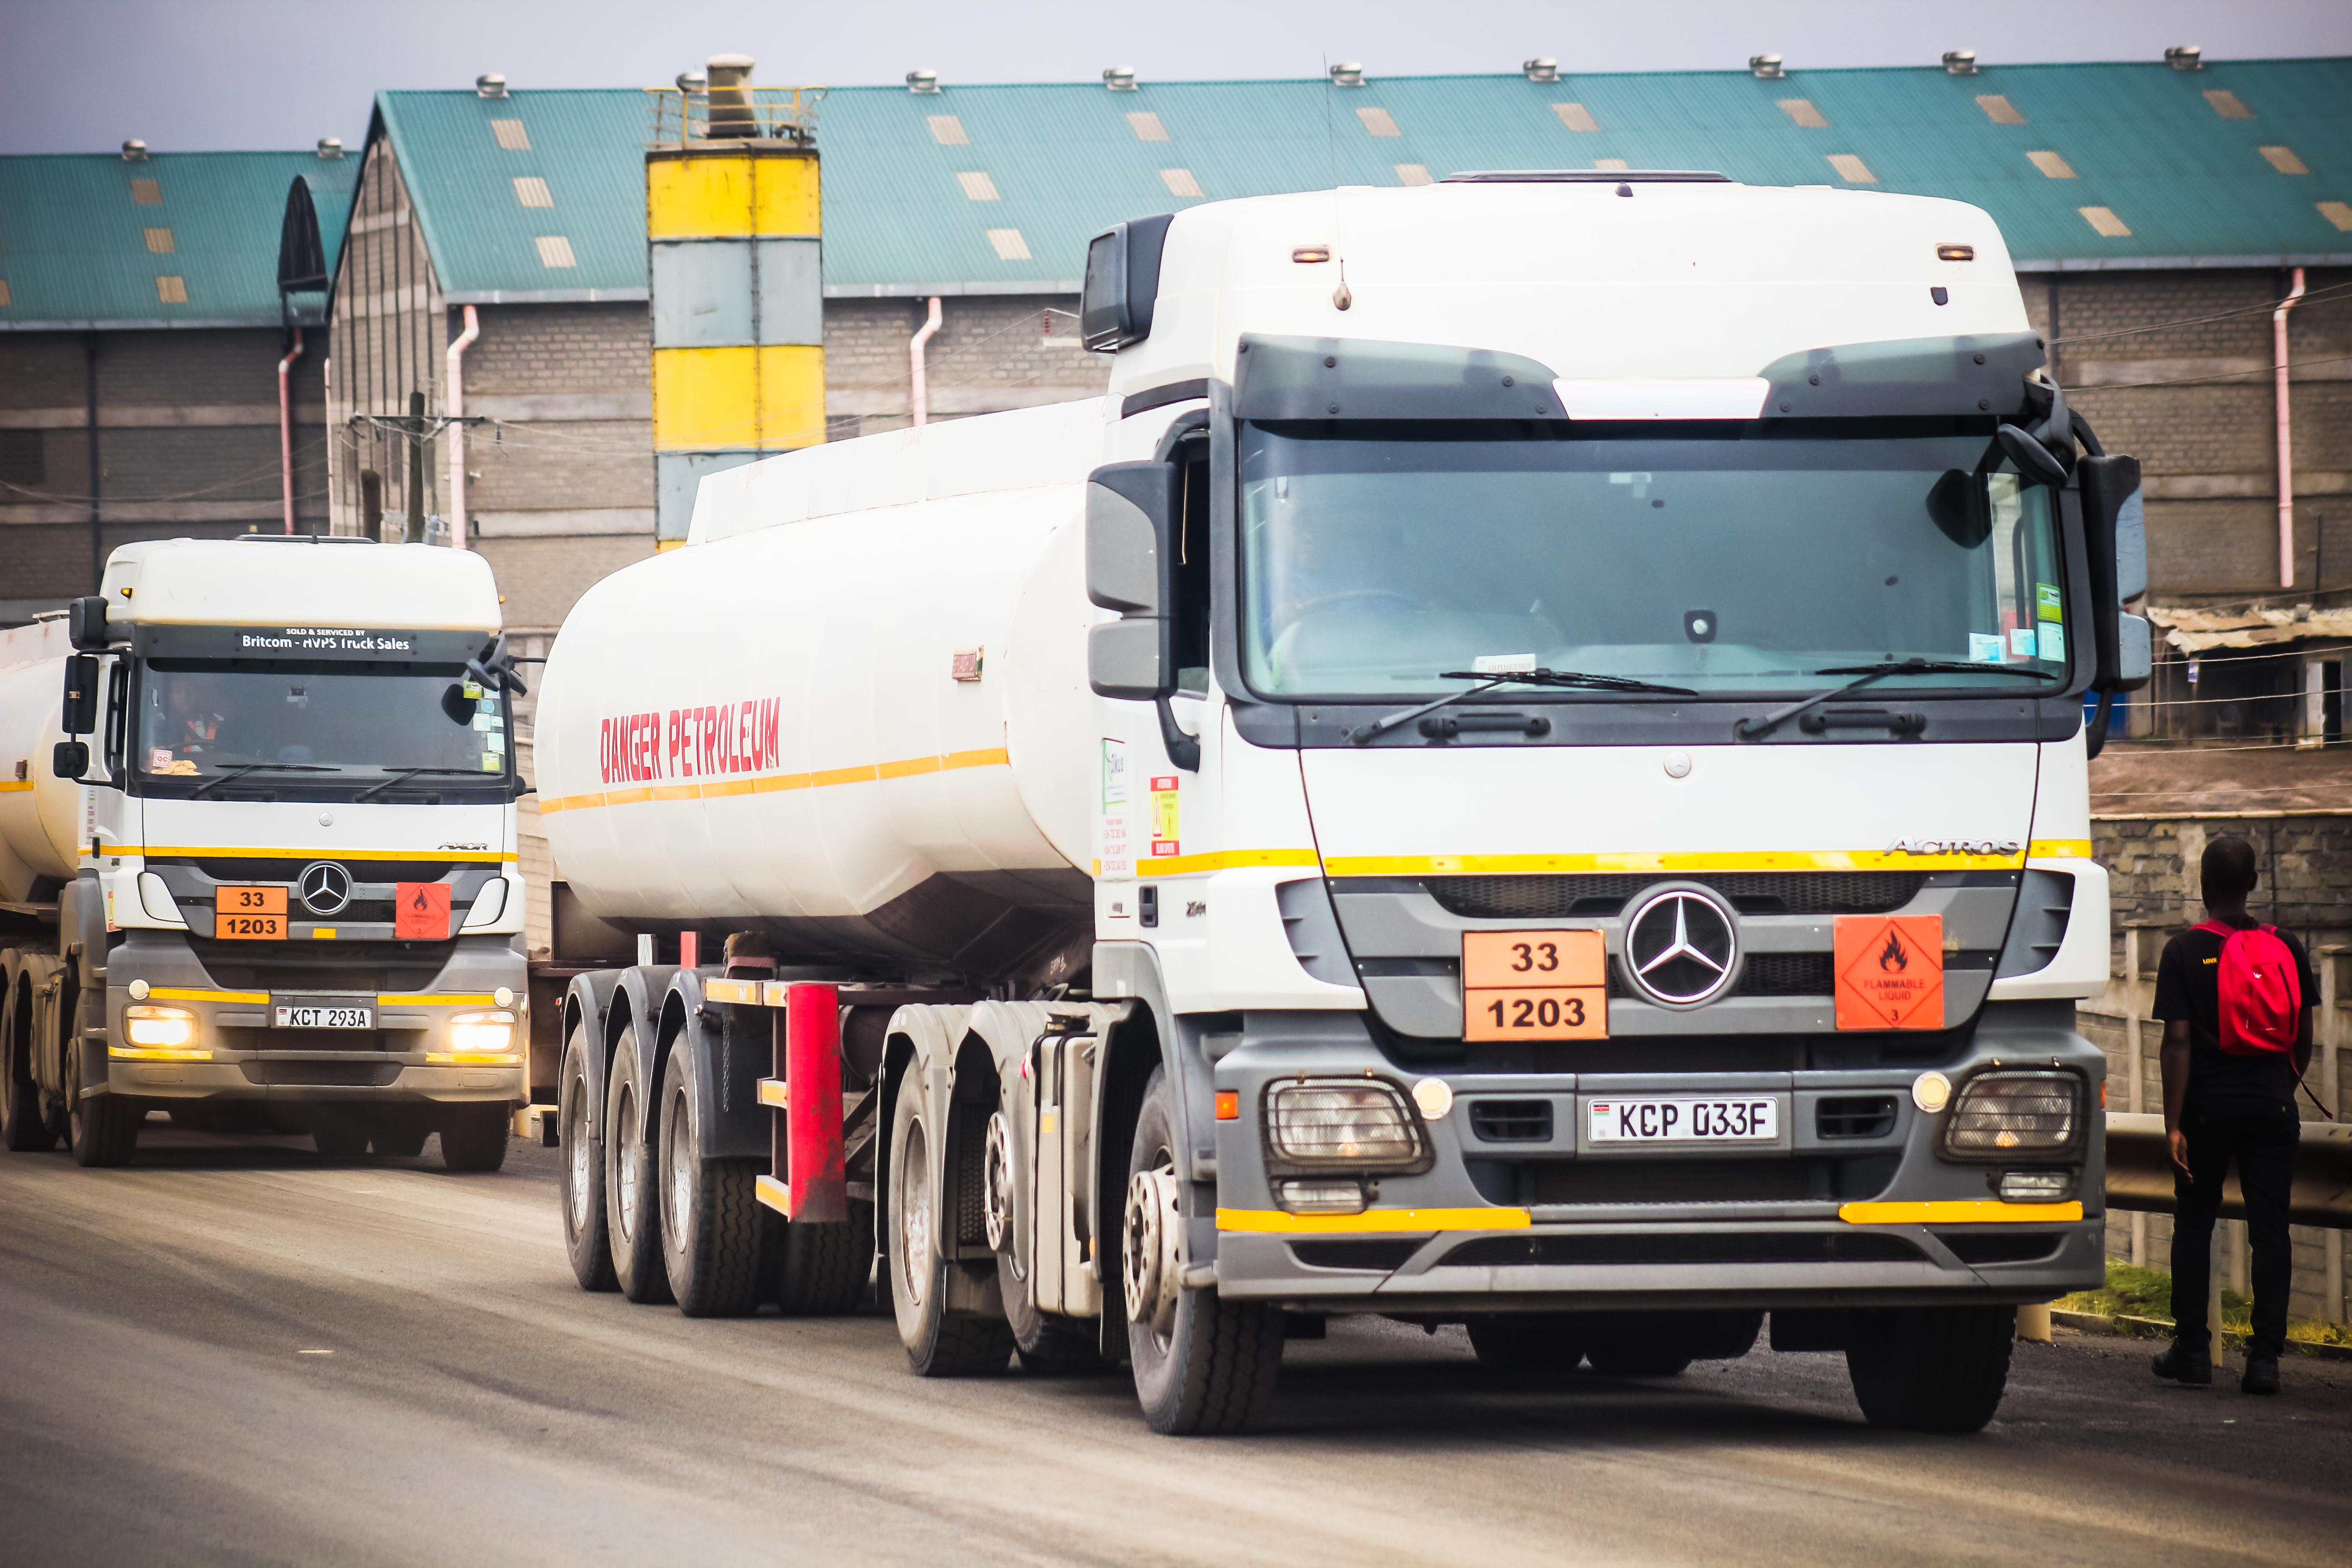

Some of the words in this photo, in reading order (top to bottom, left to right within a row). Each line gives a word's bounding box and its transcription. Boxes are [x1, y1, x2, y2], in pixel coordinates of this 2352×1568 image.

[242, 635, 292, 648] Britcom
[377, 638, 409, 650] Sales
[601, 712, 662, 784] DANGER
[668, 697, 780, 778] PETROLEUM
[240, 892, 264, 907] 33
[227, 919, 277, 934] 1203
[1511, 942, 1558, 971] 33
[1864, 980, 1925, 989] FLAMMABLE
[1878, 990, 1911, 1000] LIQUID
[291, 1009, 321, 1026] KCT
[328, 1010, 366, 1027] 293A
[1487, 998, 1585, 1028] 1203
[1891, 1009, 1899, 1021] 3
[1620, 1104, 1678, 1137] KCP
[1693, 1102, 1768, 1136] 033F
